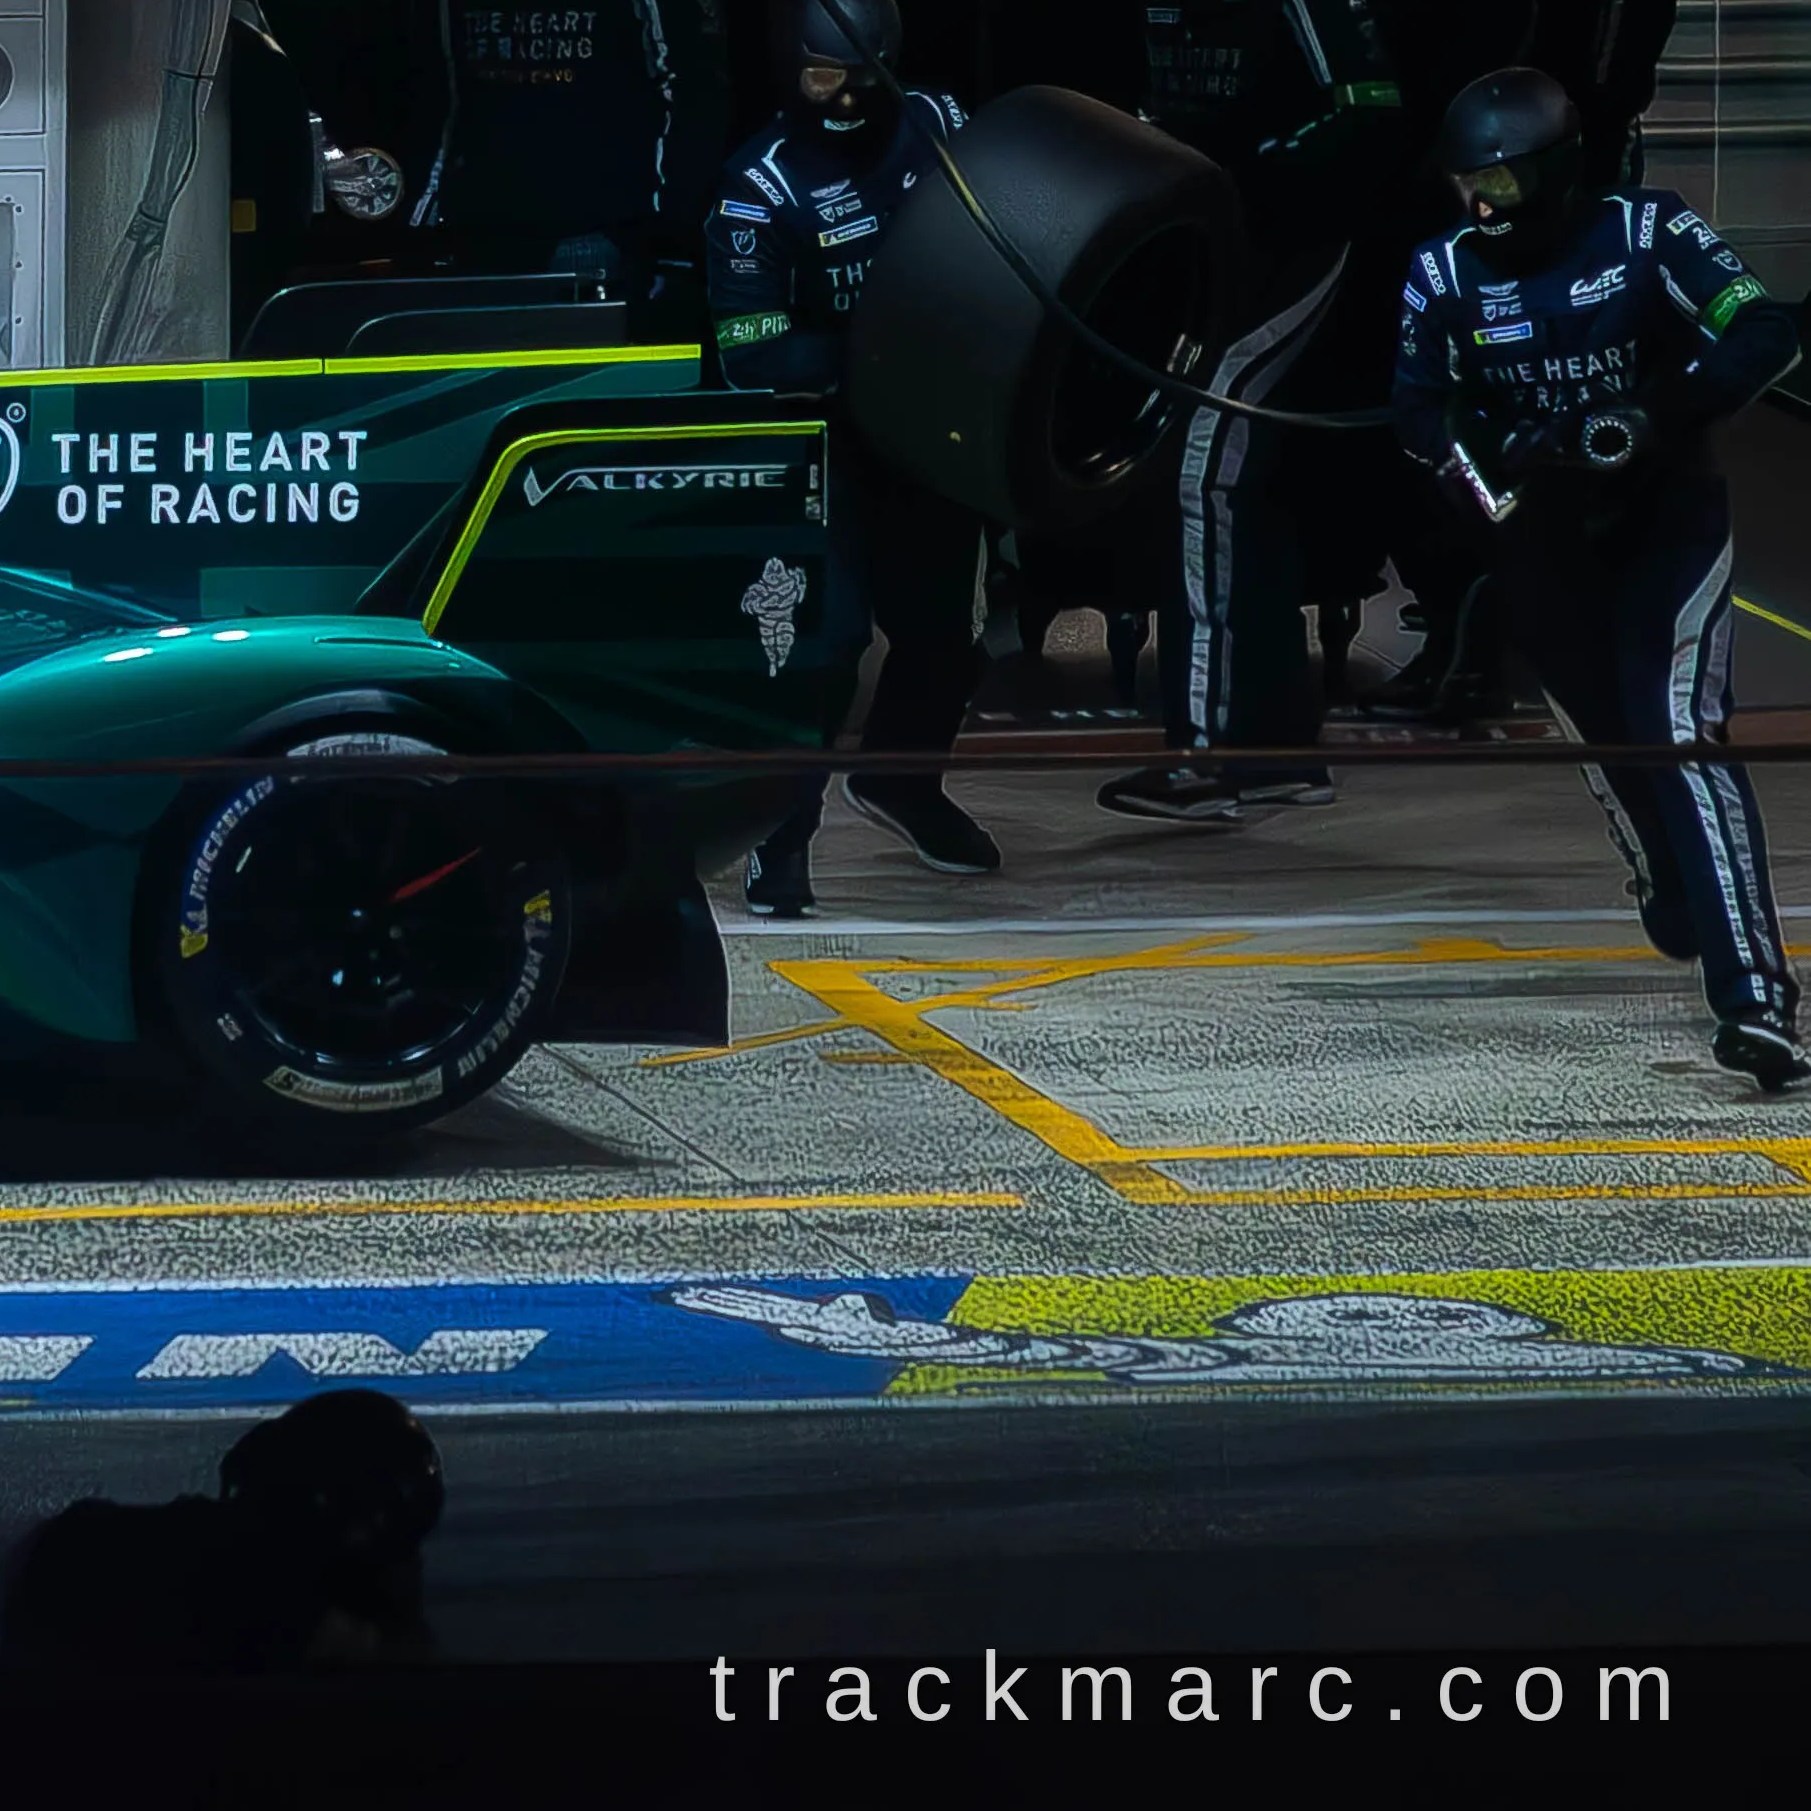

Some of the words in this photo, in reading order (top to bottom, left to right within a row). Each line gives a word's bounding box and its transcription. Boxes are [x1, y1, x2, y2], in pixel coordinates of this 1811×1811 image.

[826, 258, 873, 288] TH
[51, 432, 158, 475] THE
[184, 430, 368, 474] HEART
[57, 484, 125, 525] OF
[150, 481, 360, 525] RACING
[523, 465, 789, 507] VALKYRIE
